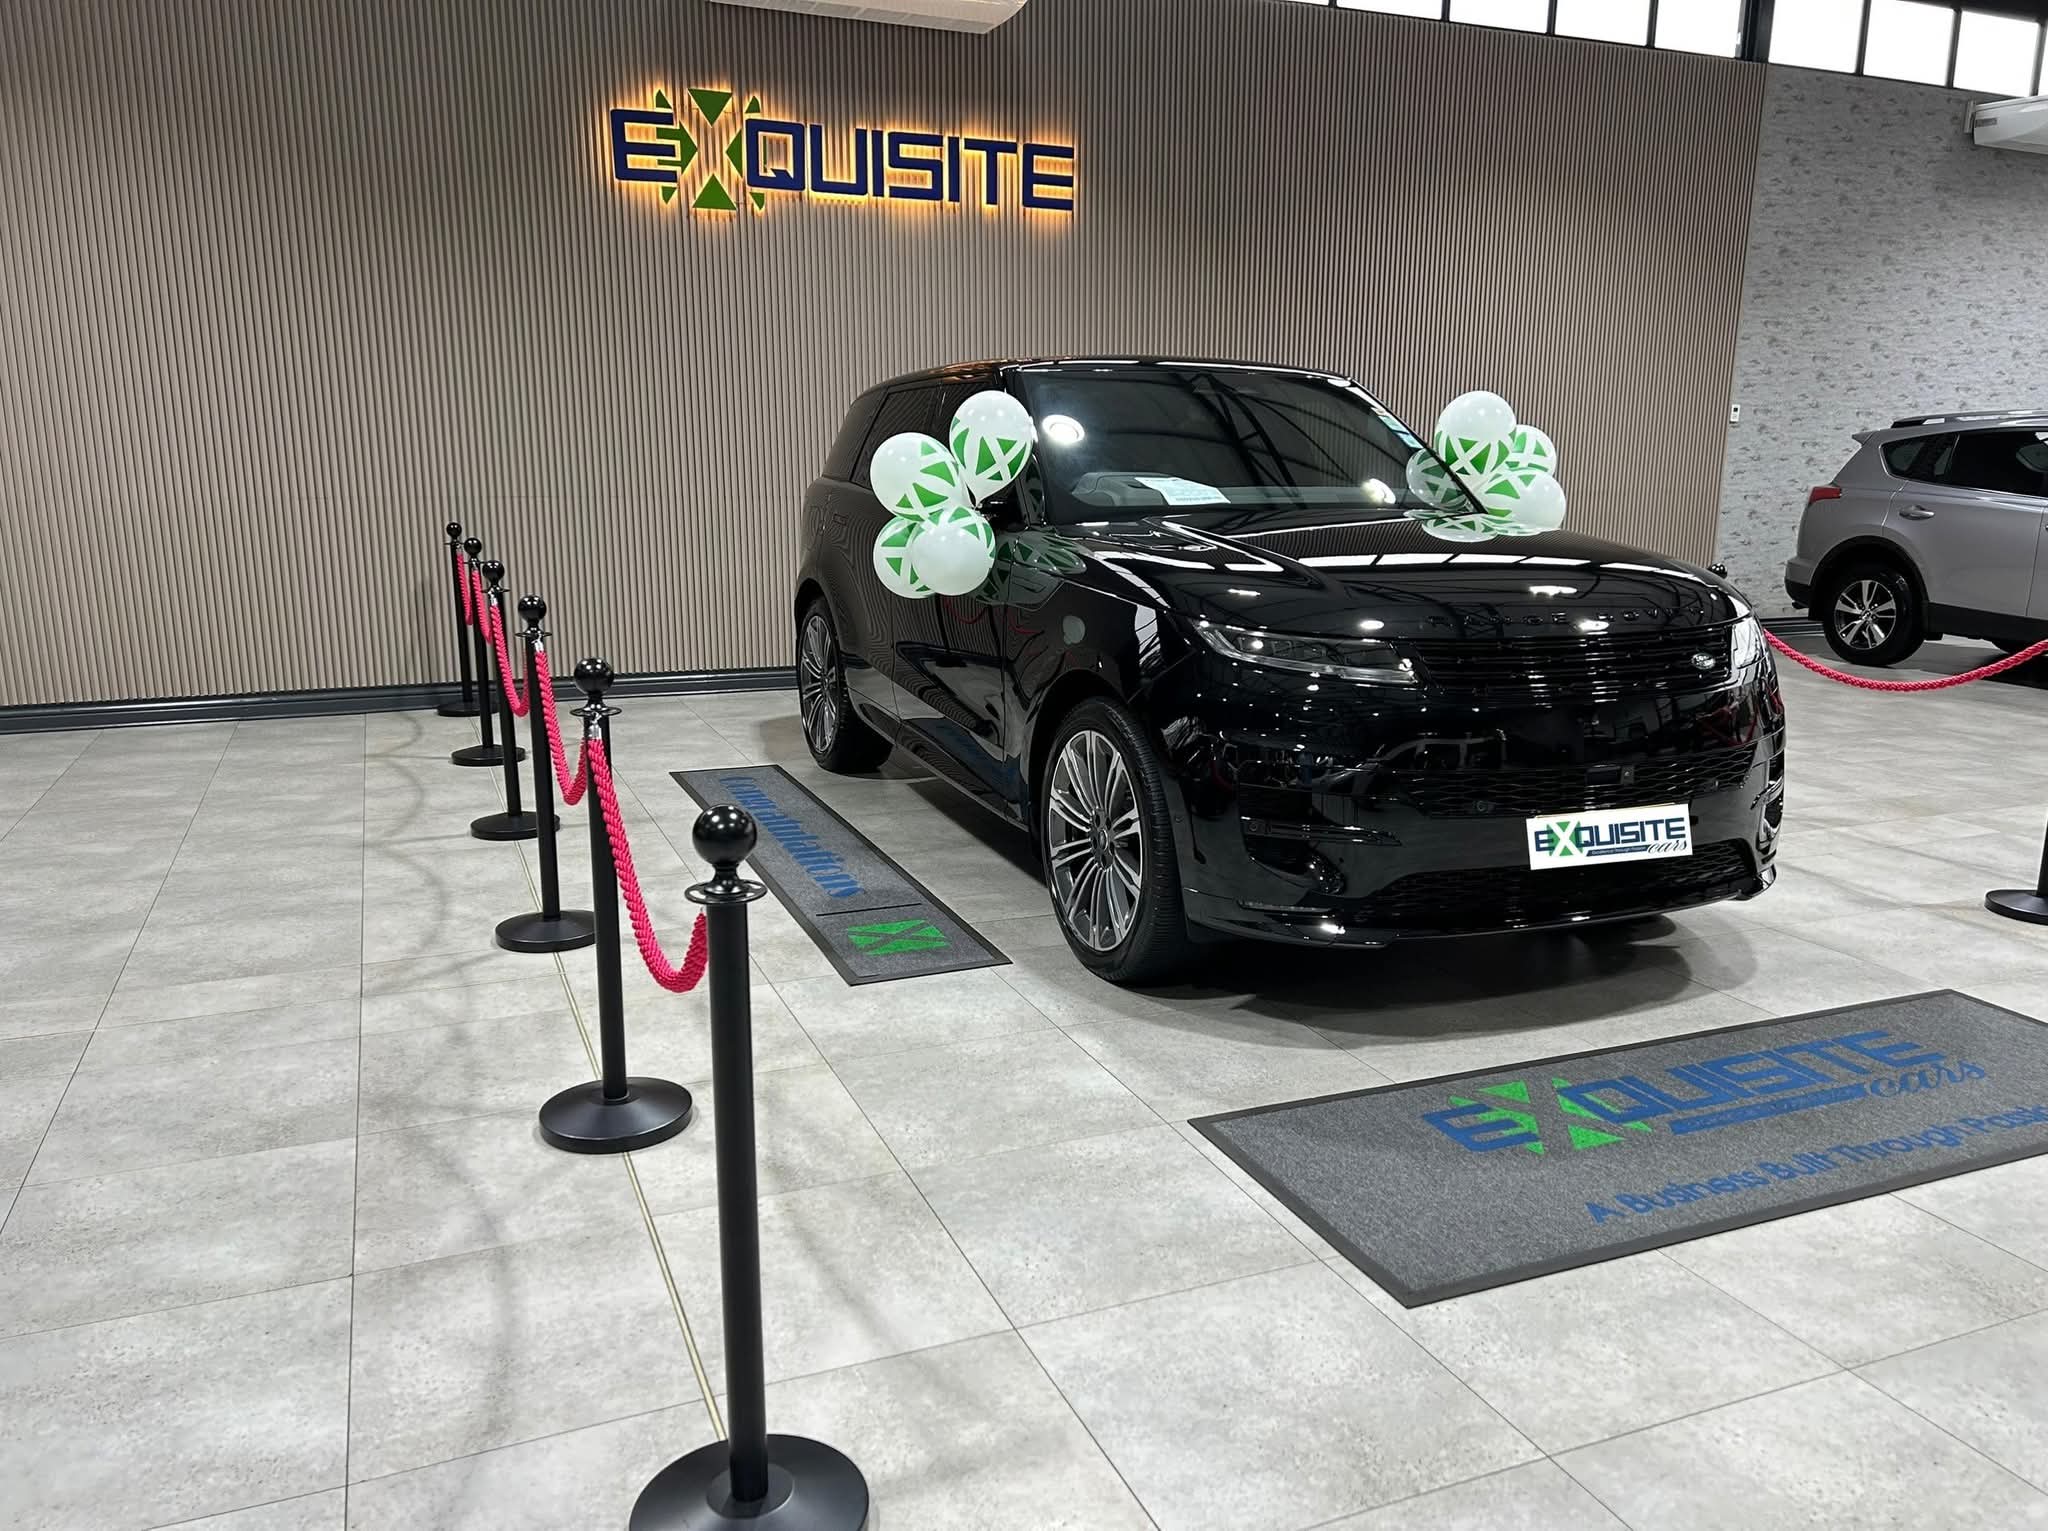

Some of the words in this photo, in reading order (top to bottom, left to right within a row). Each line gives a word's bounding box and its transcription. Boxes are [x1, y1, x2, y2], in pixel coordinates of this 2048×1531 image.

[610, 87, 1075, 212] EXQUISITE
[719, 775, 865, 898] Congratulations
[1534, 817, 1687, 858] EXQUISITE
[1646, 838, 1688, 854] cars
[1422, 1030, 1947, 1155] EXQUISITE
[1869, 1059, 1986, 1098] cars
[1584, 1202, 1627, 1226] A
[1615, 1171, 1771, 1214] Business
[1757, 1151, 1841, 1180] Built
[1826, 1124, 1963, 1163] Through
